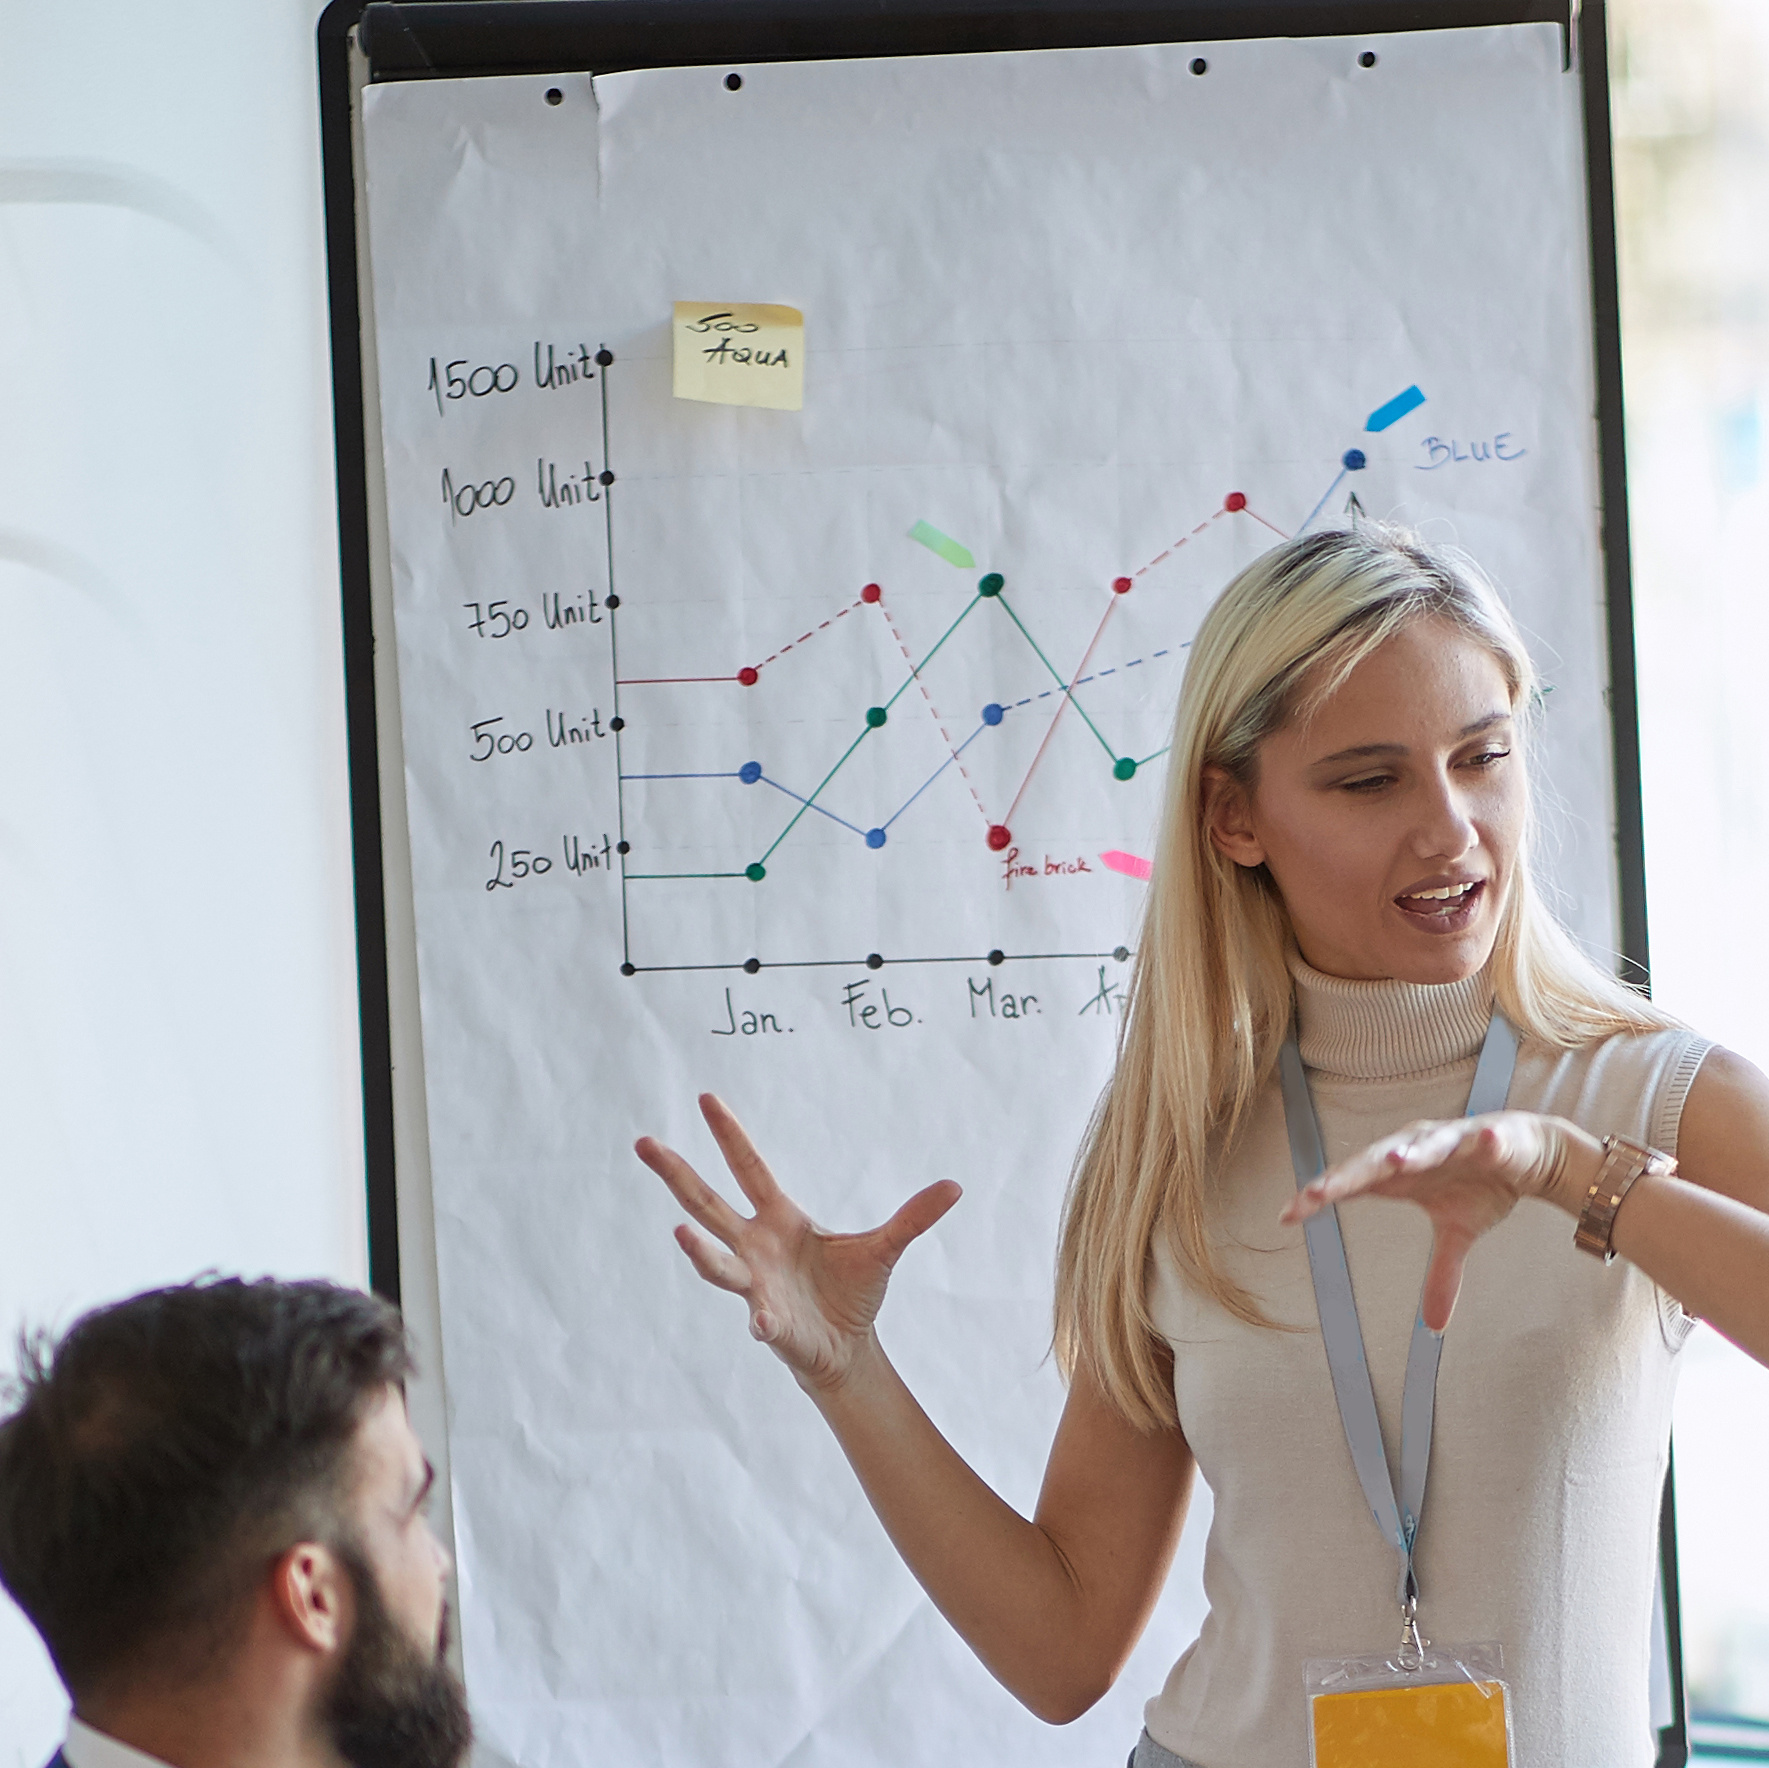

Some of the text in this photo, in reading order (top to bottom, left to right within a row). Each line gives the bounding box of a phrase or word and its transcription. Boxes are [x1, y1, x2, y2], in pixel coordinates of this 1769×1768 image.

[427, 341, 595, 418] 1500 Unit
[702, 336, 789, 369] AQUA
[1413, 431, 1527, 471] BLUE
[441, 457, 601, 528] 1000 Unit
[463, 589, 603, 638] 750 Unit
[469, 707, 606, 762] 500 Unit
[485, 832, 612, 892] 250 Unit
[710, 986, 795, 1036] Jan.
[840, 978, 924, 1030] Feb.
[967, 976, 1043, 1020] Mar.
